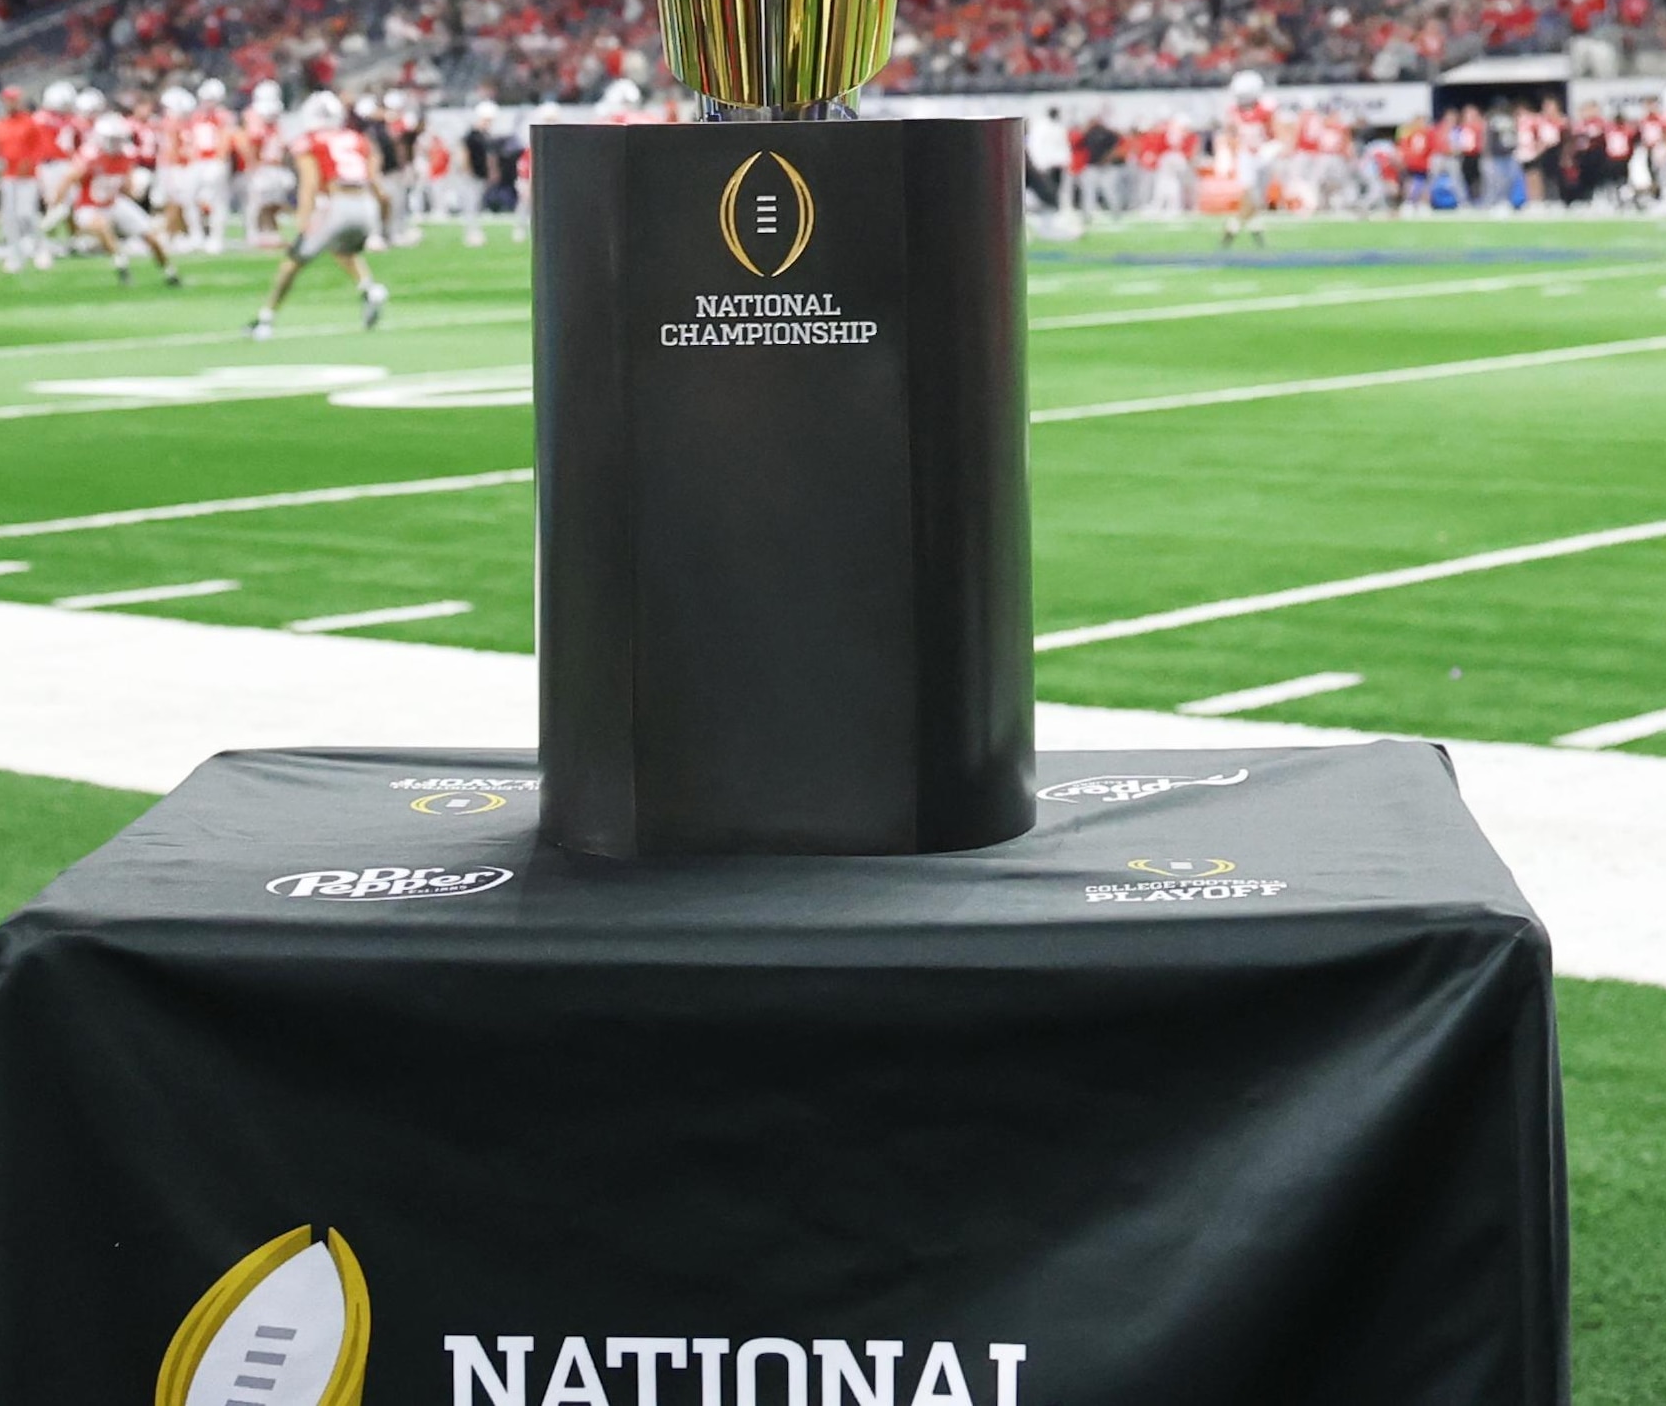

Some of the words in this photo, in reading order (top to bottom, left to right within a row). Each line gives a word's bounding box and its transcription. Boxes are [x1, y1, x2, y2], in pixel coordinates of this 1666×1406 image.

[695, 294, 841, 318] NATIONAL
[660, 320, 878, 347] CHAMPIONSHIP
[288, 868, 496, 897] Pepper
[359, 867, 445, 883] Dr
[1085, 880, 1177, 893] COLLEGE
[1085, 883, 1288, 903] PLAYOFF
